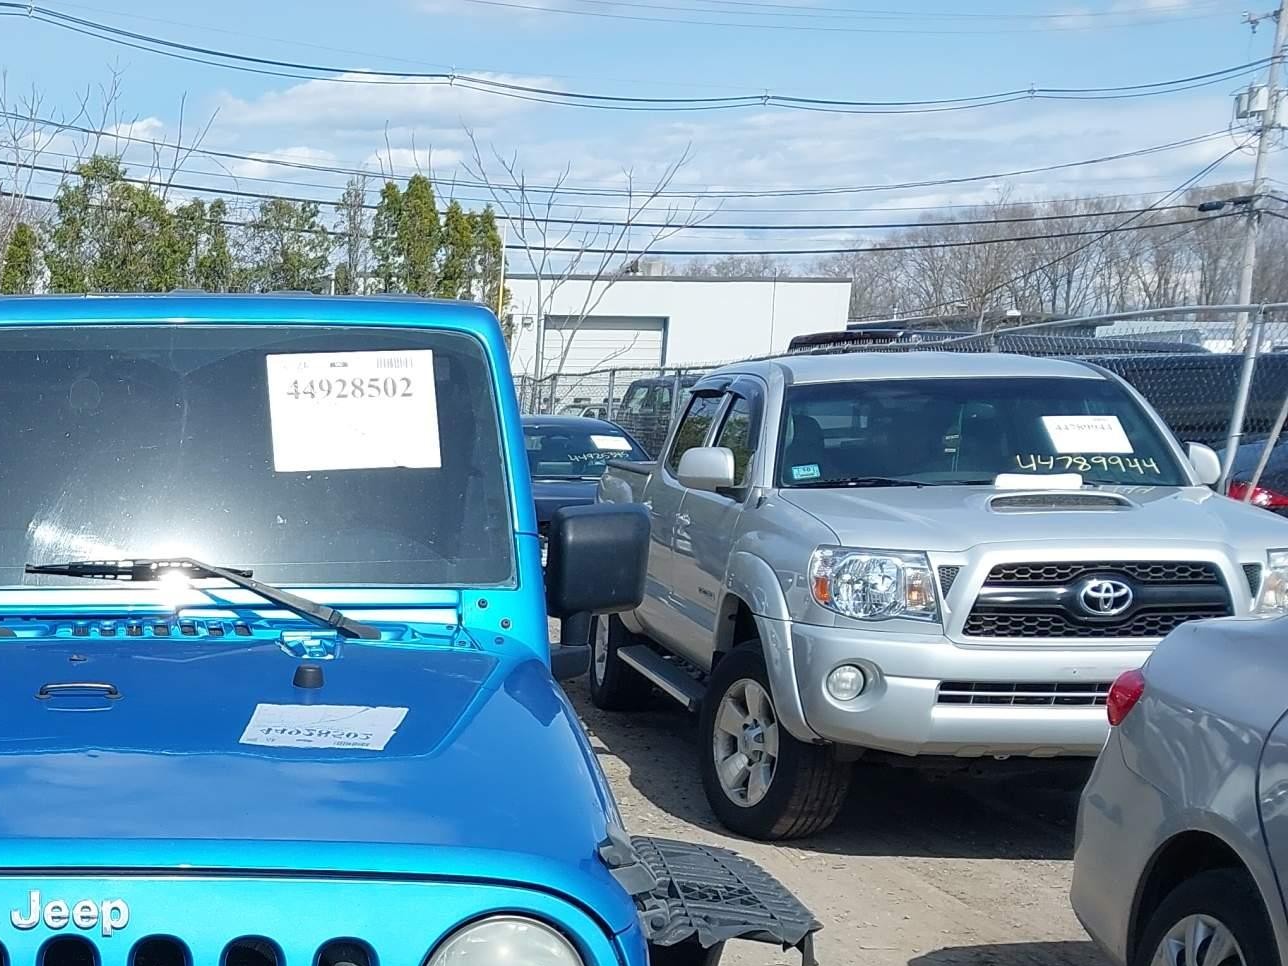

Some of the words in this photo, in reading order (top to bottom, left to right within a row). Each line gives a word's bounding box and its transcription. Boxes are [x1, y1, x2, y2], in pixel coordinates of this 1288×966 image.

[286, 377, 414, 399] 44928502
[1016, 454, 1161, 474] 44789944
[10, 889, 130, 937] Jeep
